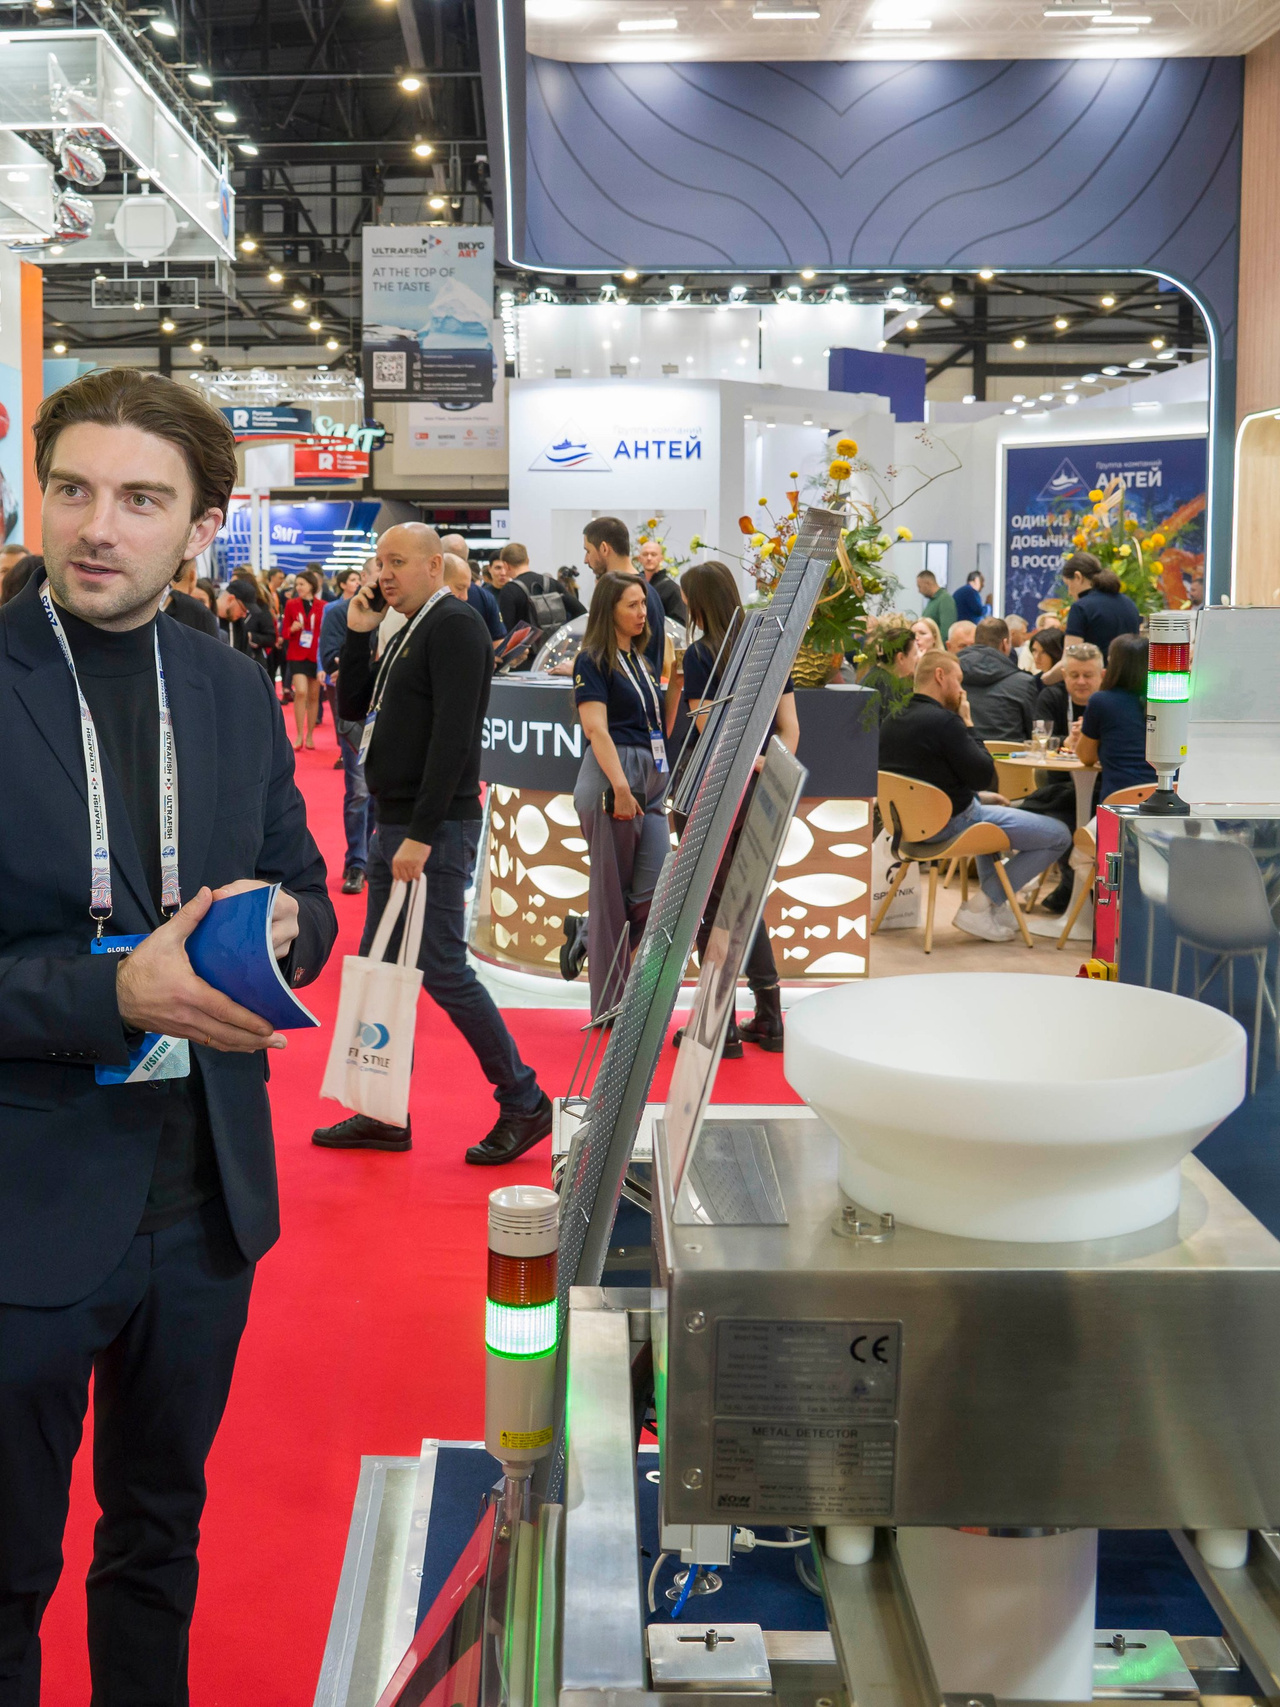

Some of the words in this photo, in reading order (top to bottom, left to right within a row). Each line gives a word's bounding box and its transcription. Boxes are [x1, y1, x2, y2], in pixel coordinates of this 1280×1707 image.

[458, 250, 478, 258] ART
[372, 267, 386, 277] AT
[389, 267, 410, 277] THE
[414, 267, 436, 277] TOP
[439, 267, 455, 277] OF
[373, 282, 394, 292] THE
[397, 282, 430, 292] TASTE
[614, 435, 702, 459] АНТЕЙ
[496, 520, 506, 528] T8
[1011, 556, 1019, 567] В
[1022, 555, 1067, 569] РОССИ
[481, 717, 582, 758] SPUTN
[86, 728, 95, 773] ULTRAFISH
[93, 794, 102, 840] ULTRAFISH
[873, 886, 916, 901] SPTNIK
[142, 1040, 171, 1072] VISITOR
[850, 1335, 889, 1364] CE
[752, 1427, 790, 1436] METAL
[797, 1429, 858, 1439] DETECTOR
